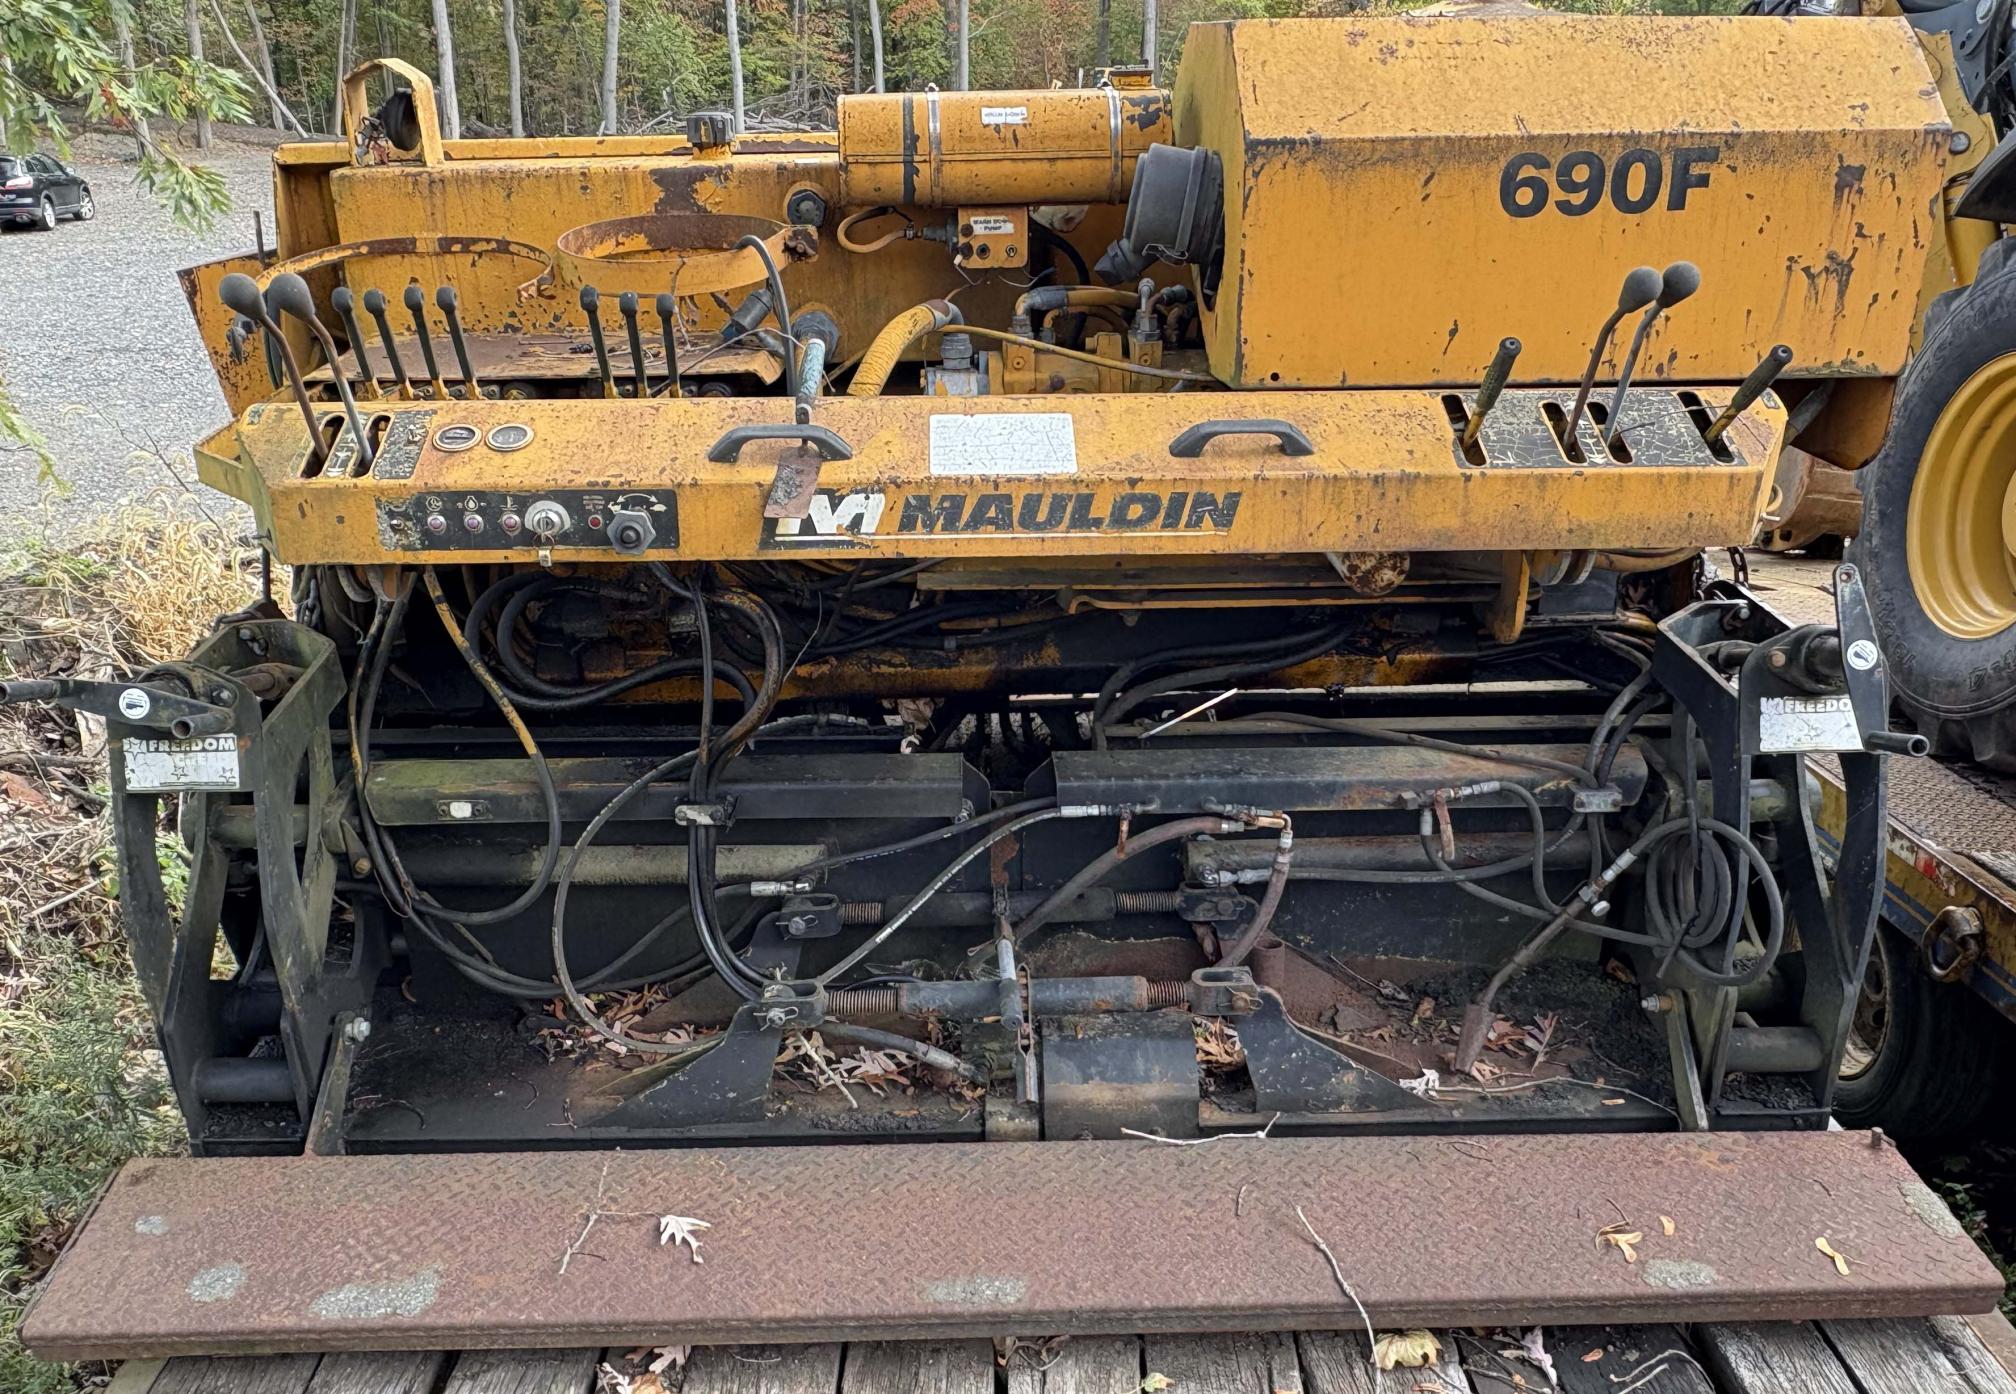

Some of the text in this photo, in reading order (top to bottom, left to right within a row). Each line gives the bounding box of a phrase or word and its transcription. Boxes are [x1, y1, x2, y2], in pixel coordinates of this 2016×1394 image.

[1500, 146, 1721, 218] 690F
[898, 491, 1242, 532] MAULDIN
[1785, 699, 1852, 714] FREEDO
[148, 737, 235, 752] FREEDOM
